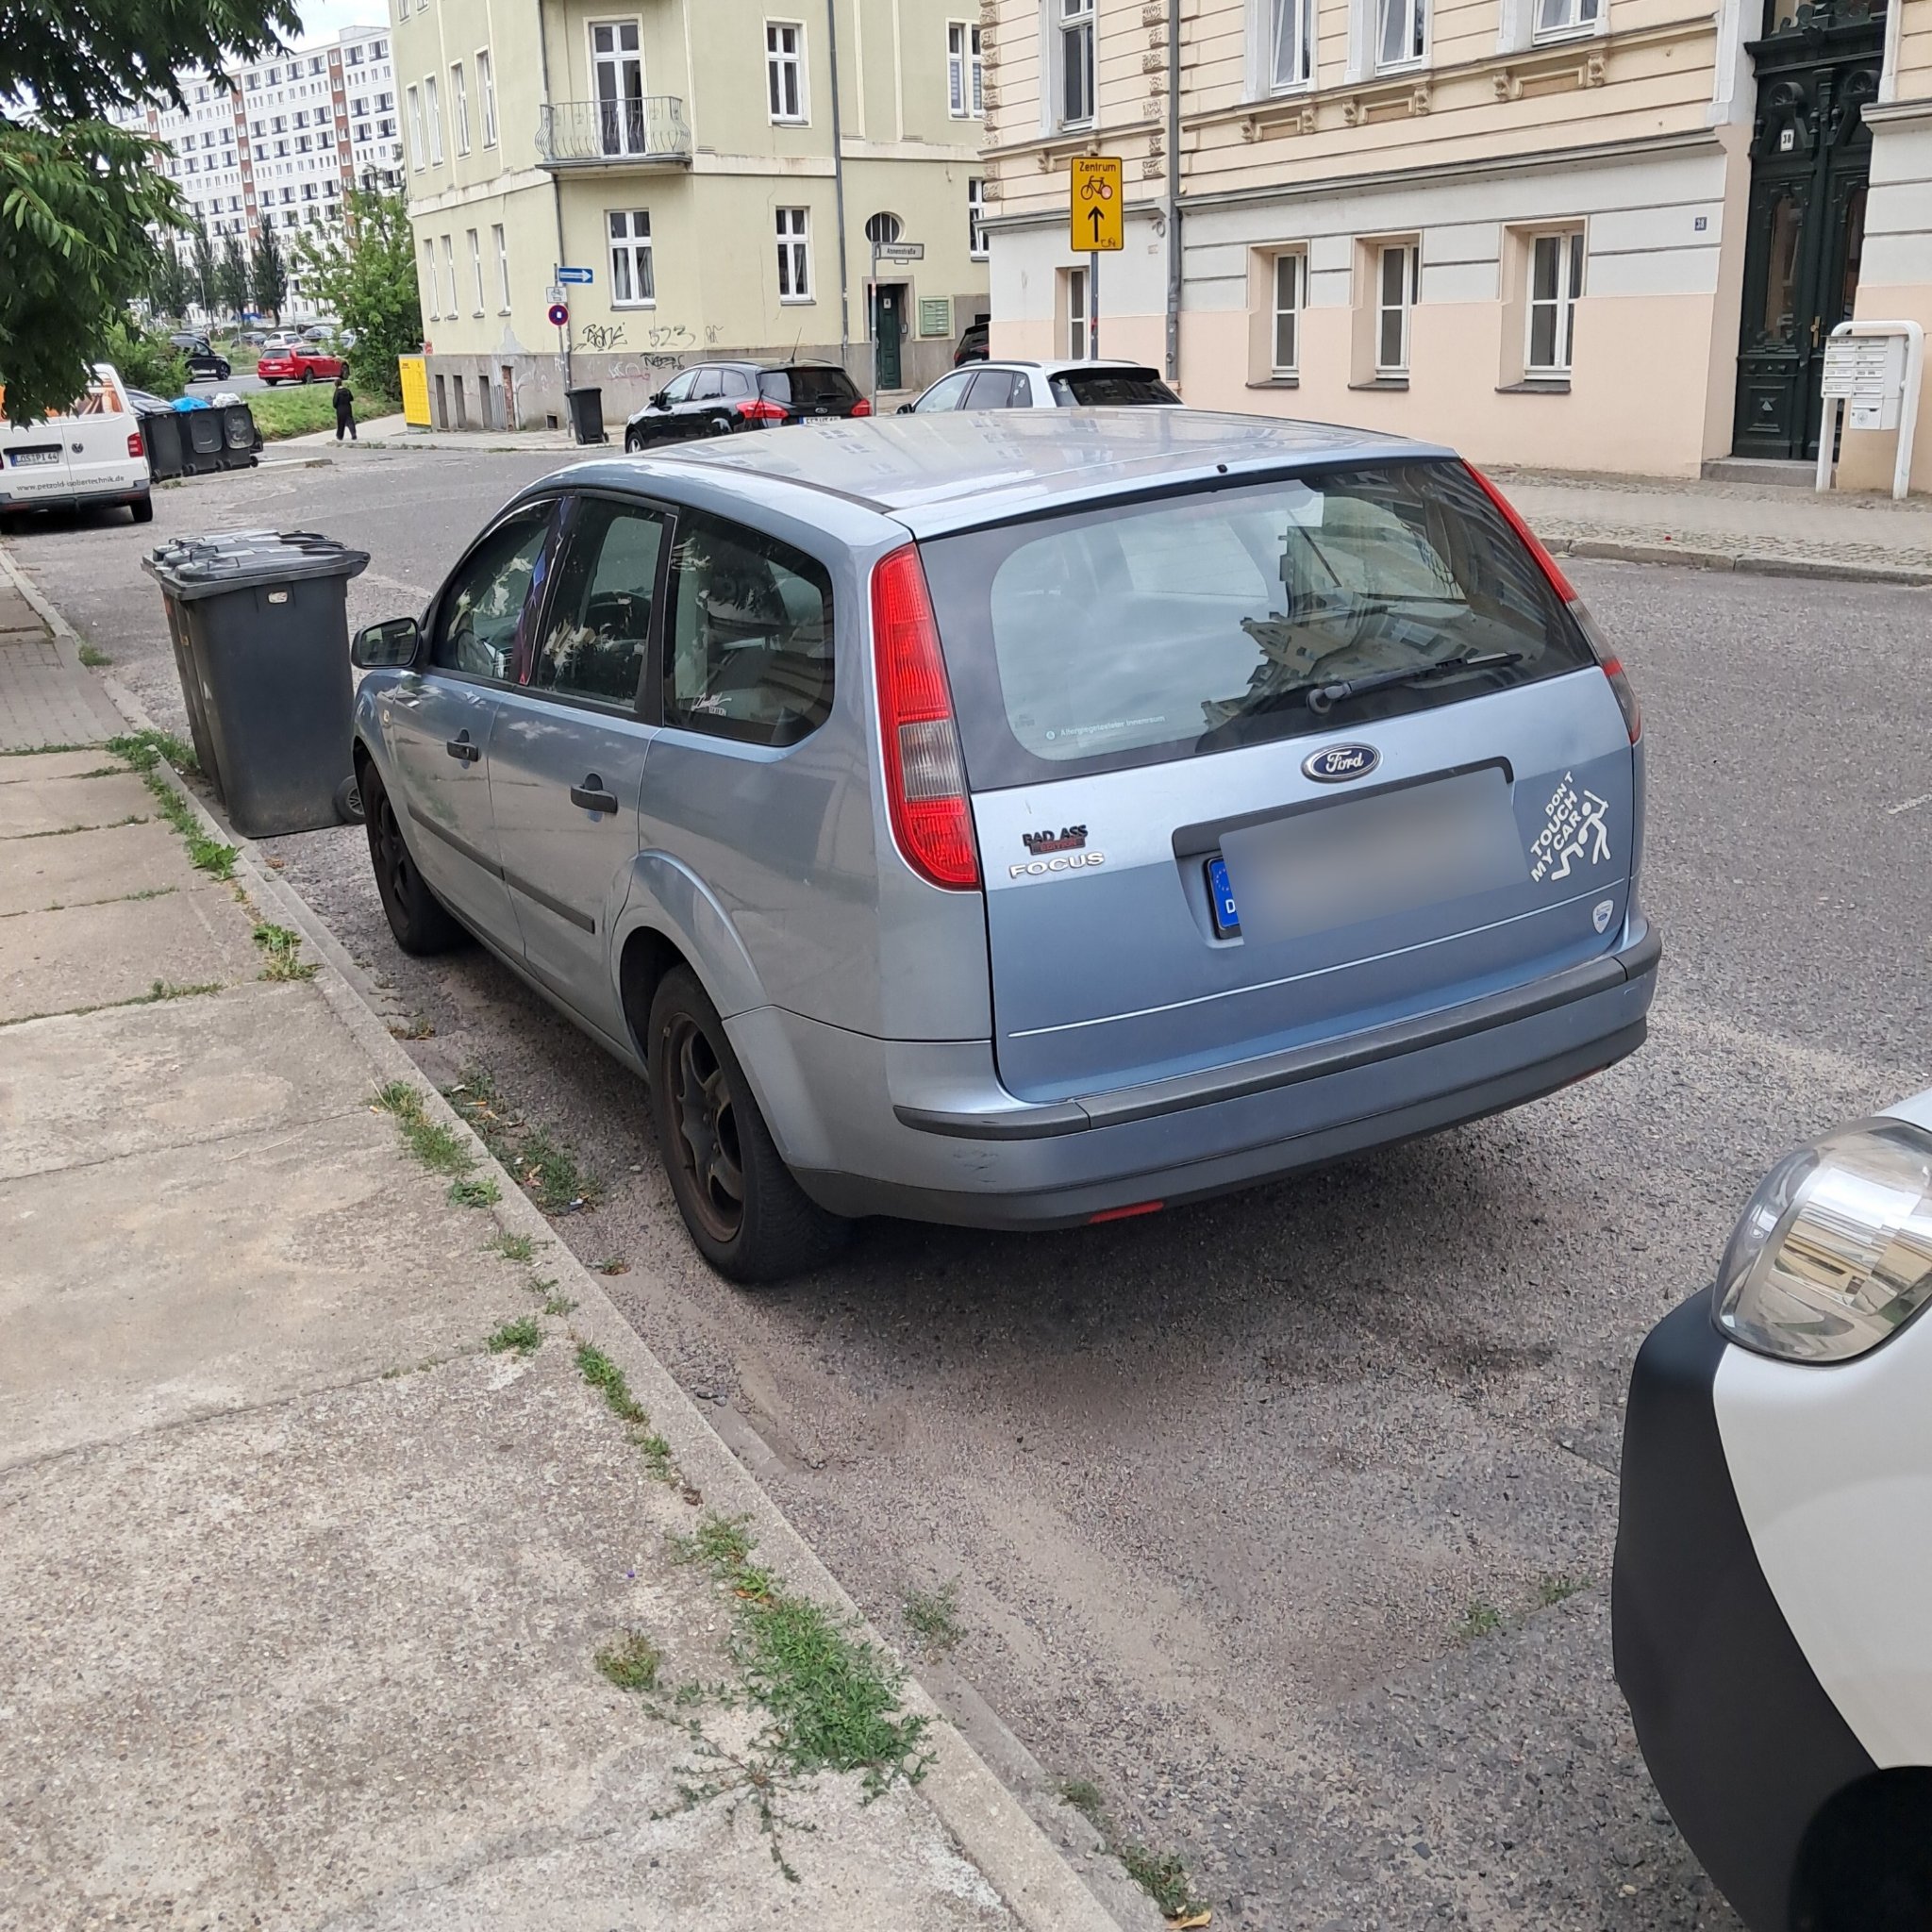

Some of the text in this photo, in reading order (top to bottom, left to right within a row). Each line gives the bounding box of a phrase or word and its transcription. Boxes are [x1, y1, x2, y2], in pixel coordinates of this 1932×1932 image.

[1783, 134, 1791, 143] 38
[1079, 161, 1116, 172] Zentrum
[1325, 751, 1364, 773] Ford
[1530, 791, 1578, 857] TOUCH
[1022, 824, 1089, 847] BAD ASS
[1530, 810, 1582, 882] MY CAR
[1009, 851, 1106, 879] FOCUS
[1225, 899, 1237, 914] D
